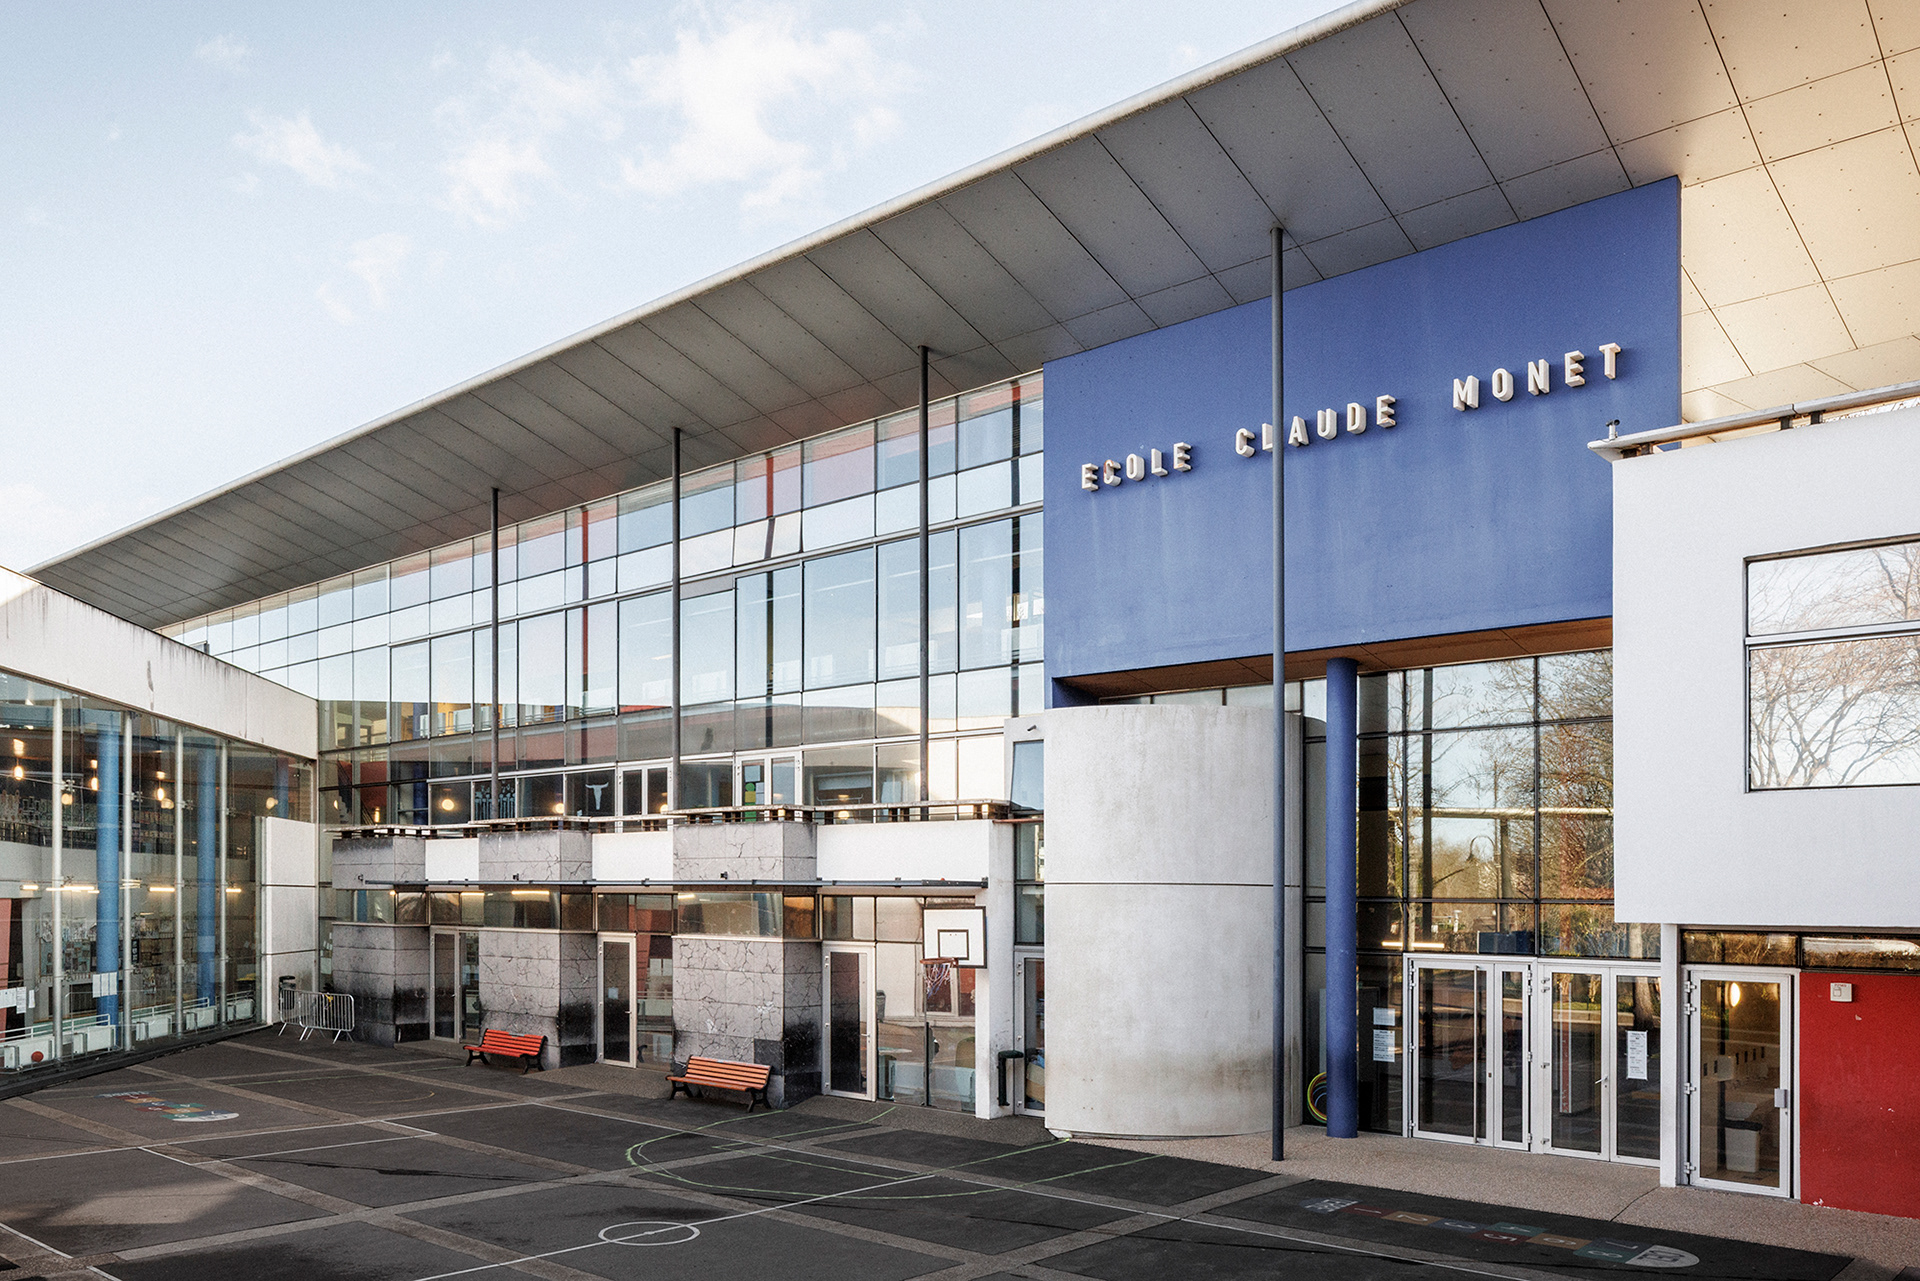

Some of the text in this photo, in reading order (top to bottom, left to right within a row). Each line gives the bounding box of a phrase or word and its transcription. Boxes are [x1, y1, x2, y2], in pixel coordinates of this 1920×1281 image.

[1081, 342, 1621, 492] ECOLE CLAUDE MONET
[1397, 1213, 1428, 1222] 2
[1444, 1221, 1476, 1230] 3
[1483, 1232, 1518, 1242] 5
[1543, 1237, 1577, 1246] 6
[1605, 1240, 1639, 1249] 7
[1588, 1250, 1623, 1259] 8
